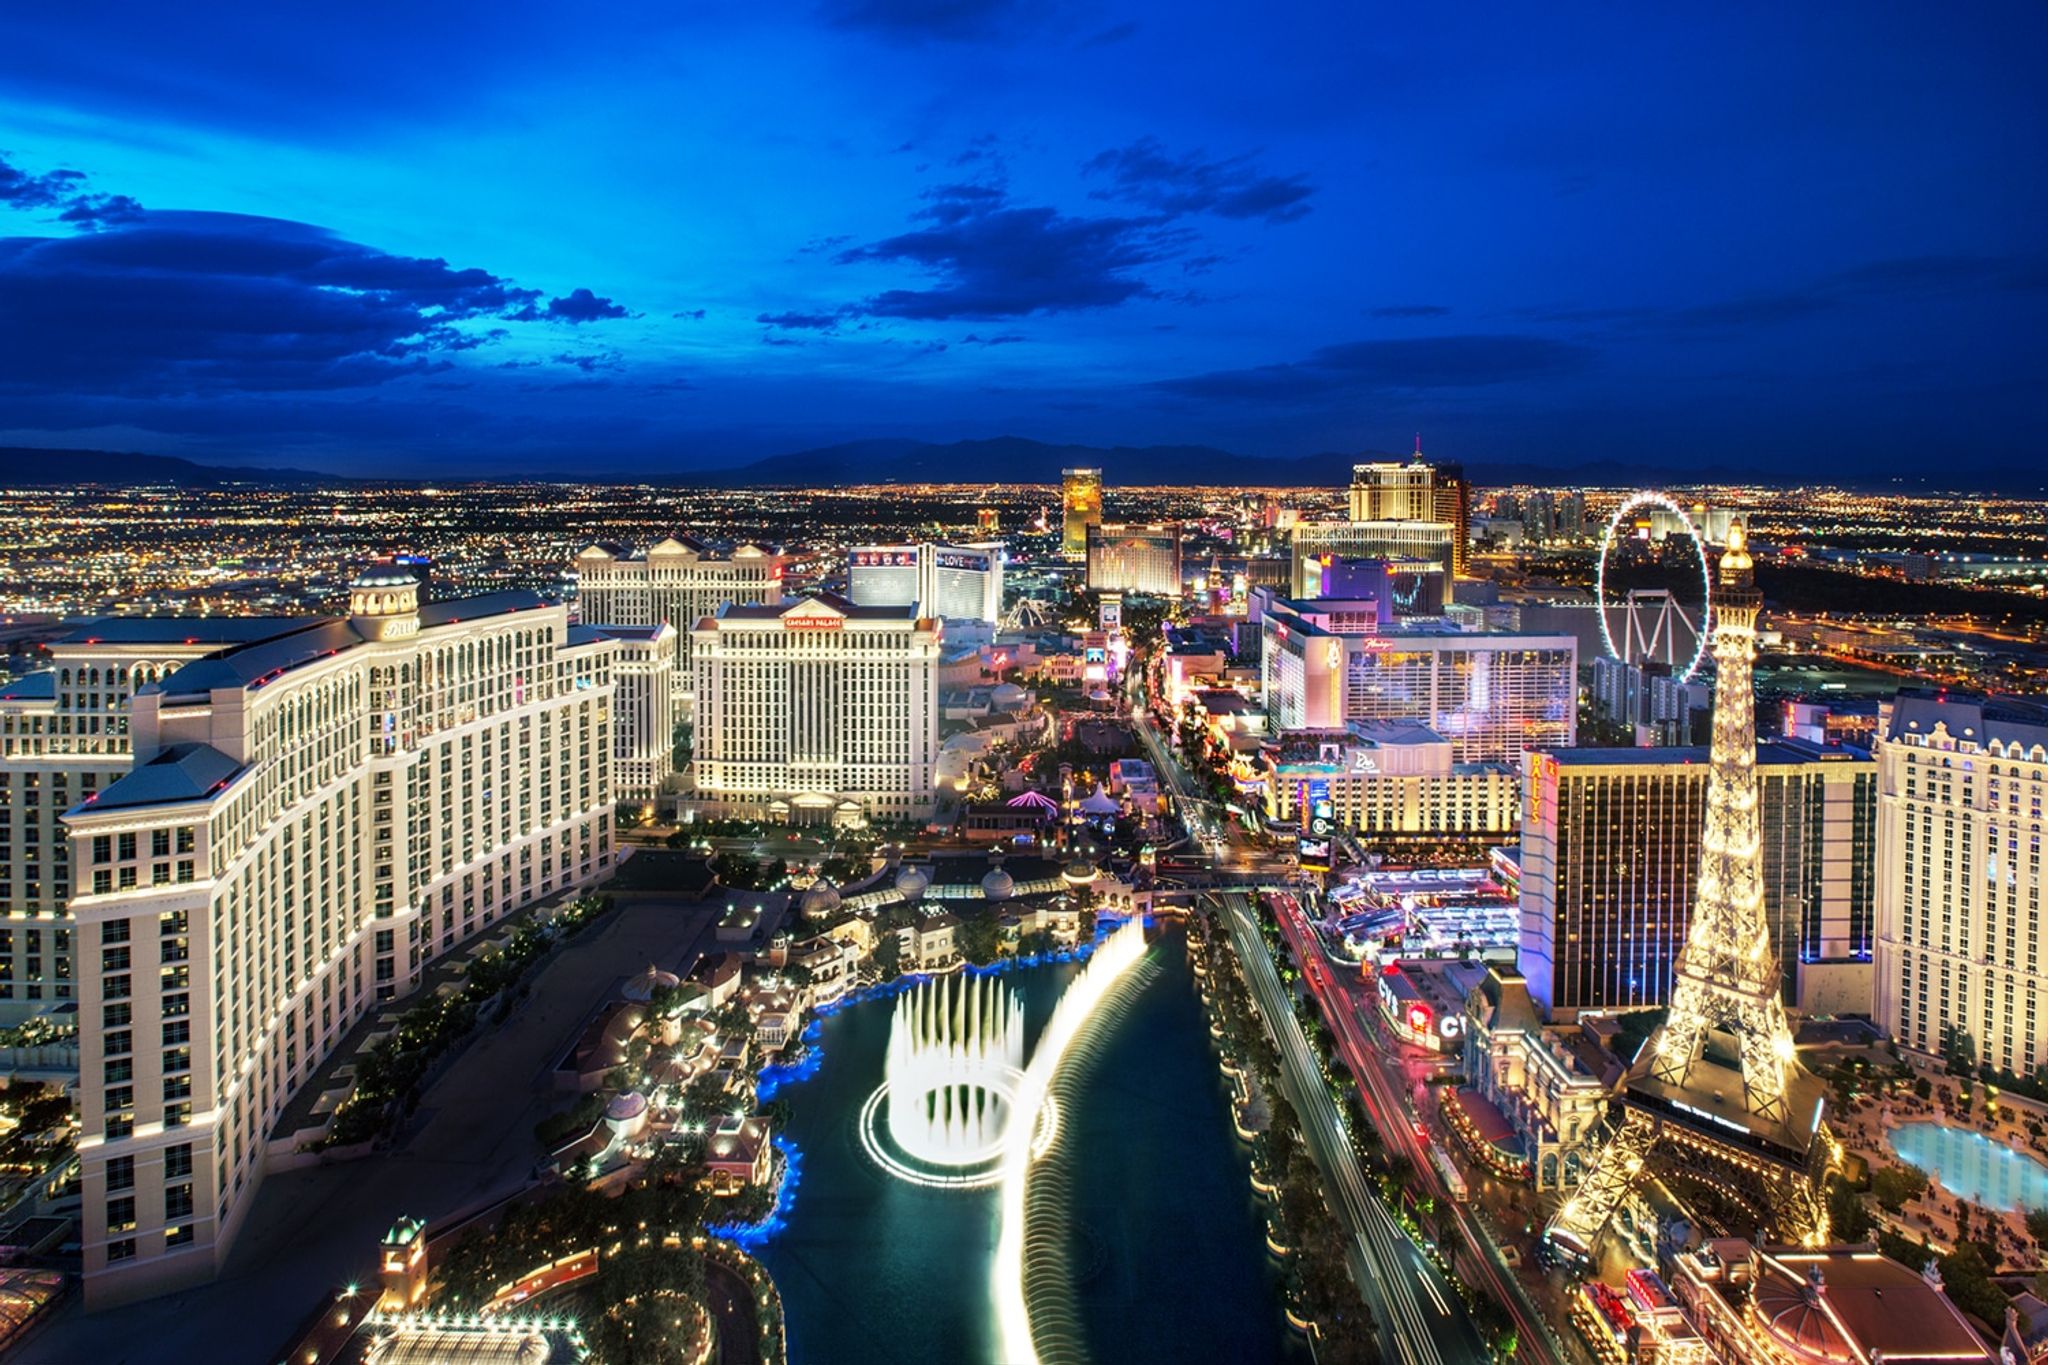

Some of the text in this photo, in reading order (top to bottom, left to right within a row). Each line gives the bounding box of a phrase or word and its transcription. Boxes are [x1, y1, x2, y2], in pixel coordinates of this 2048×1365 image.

[944, 556, 965, 567] LOVE
[786, 618, 840, 627] CAESARS PALACE
